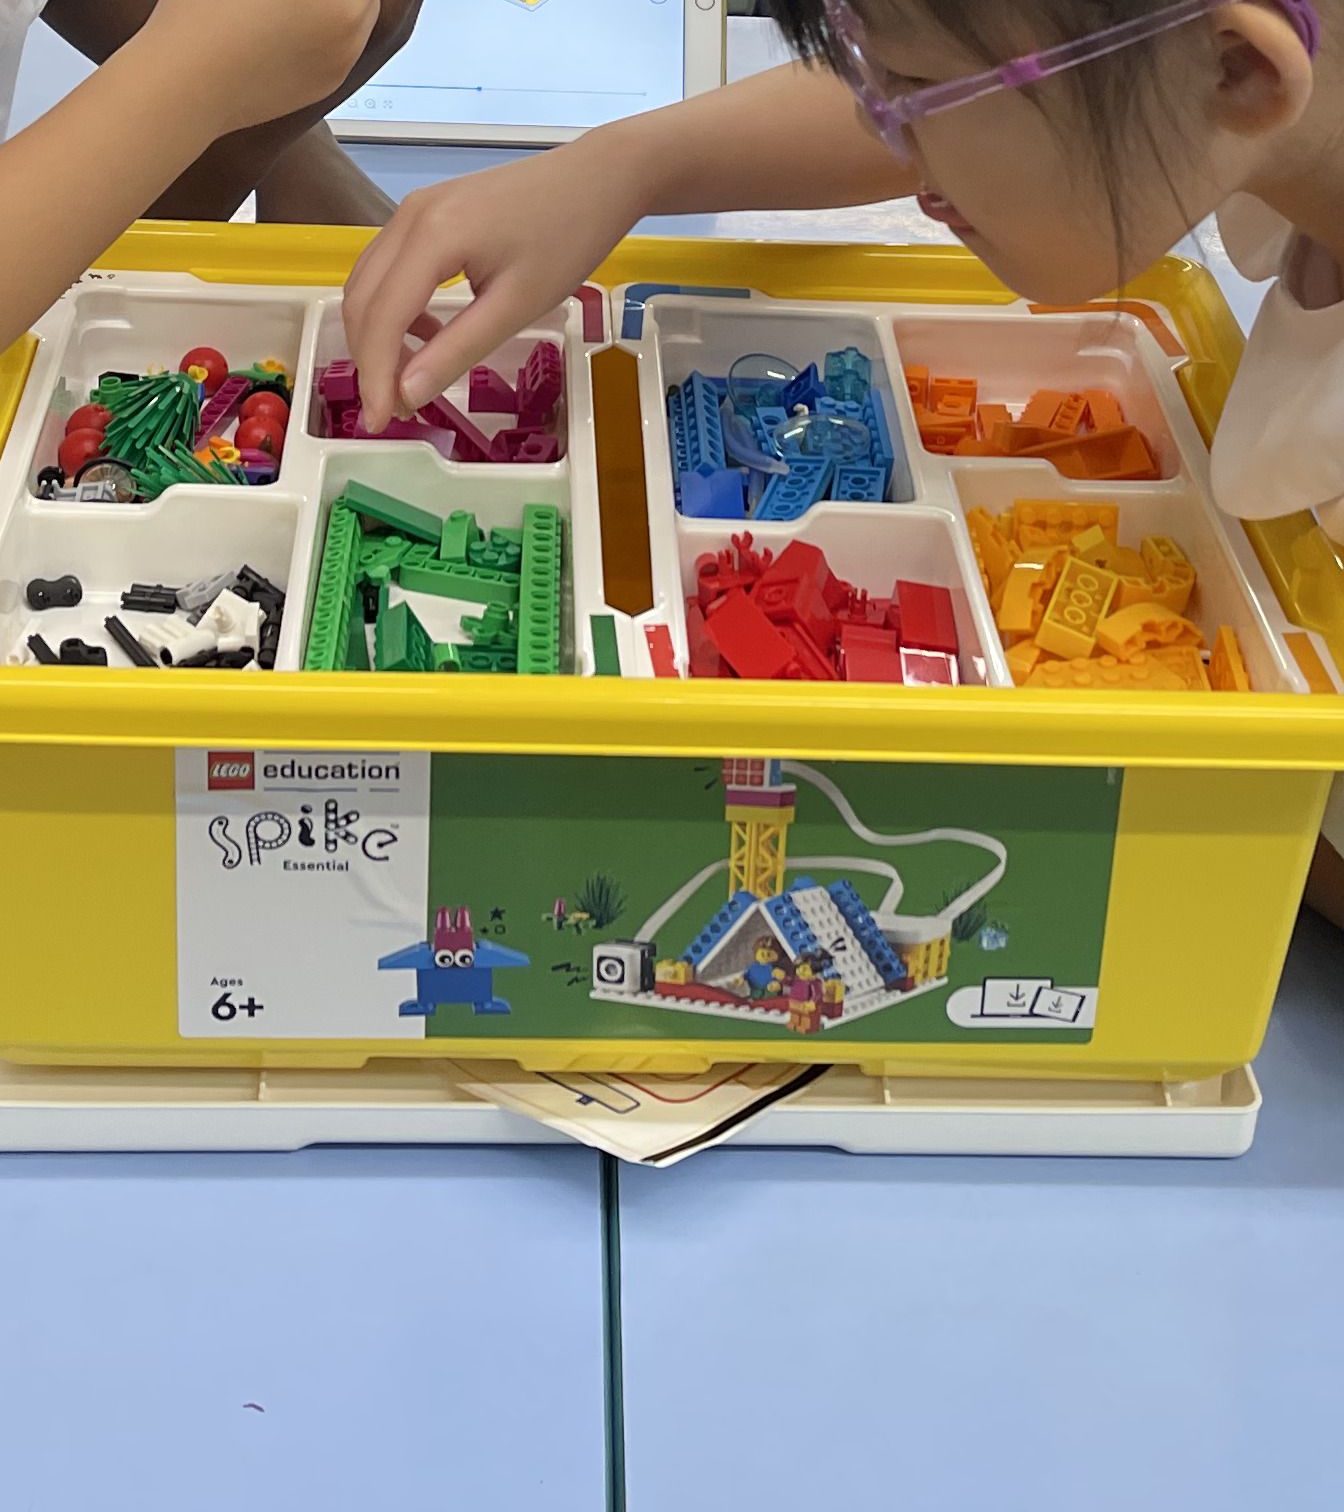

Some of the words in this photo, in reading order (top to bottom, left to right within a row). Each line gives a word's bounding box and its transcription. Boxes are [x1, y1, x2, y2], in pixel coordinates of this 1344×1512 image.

[211, 761, 251, 778] LEGO
[263, 759, 400, 781] education
[283, 860, 349, 872] Essential
[210, 976, 243, 988] Ages
[211, 992, 264, 1021] 6+
